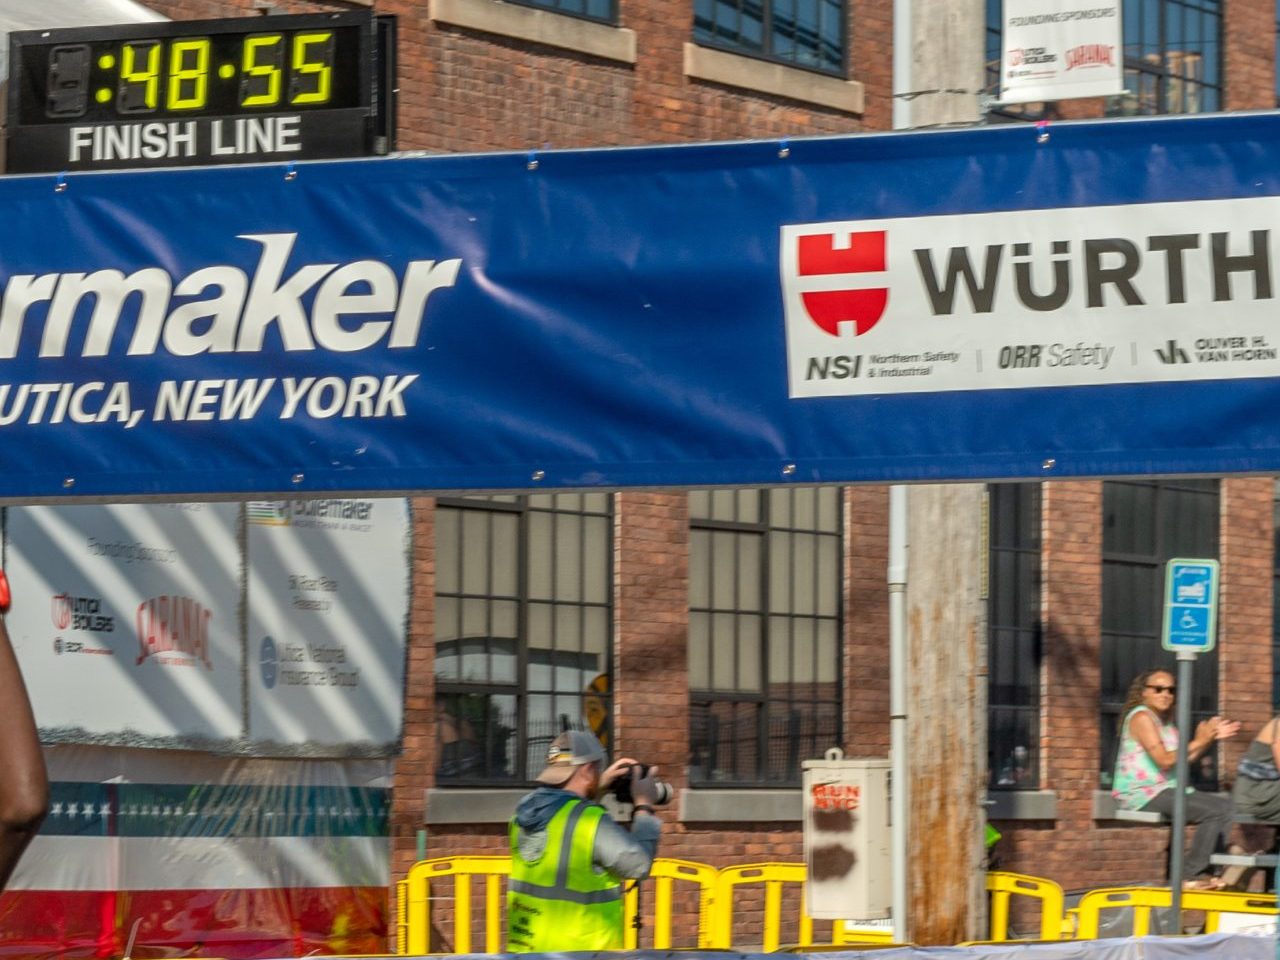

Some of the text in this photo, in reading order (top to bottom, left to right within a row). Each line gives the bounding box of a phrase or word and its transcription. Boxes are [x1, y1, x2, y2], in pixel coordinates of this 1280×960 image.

[69, 115, 302, 162] FINISH LINE
[998, 341, 1116, 370] ORR Safety
[1195, 336, 1247, 350] OLIVER
[1195, 348, 1278, 363] VAN HORN
[806, 354, 863, 380] NSI
[870, 350, 960, 364] Northern Safety
[153, 378, 281, 422] NEW
[278, 374, 420, 419] YORK
[135, 595, 213, 671] SARANAC
[811, 784, 860, 797] RUN
